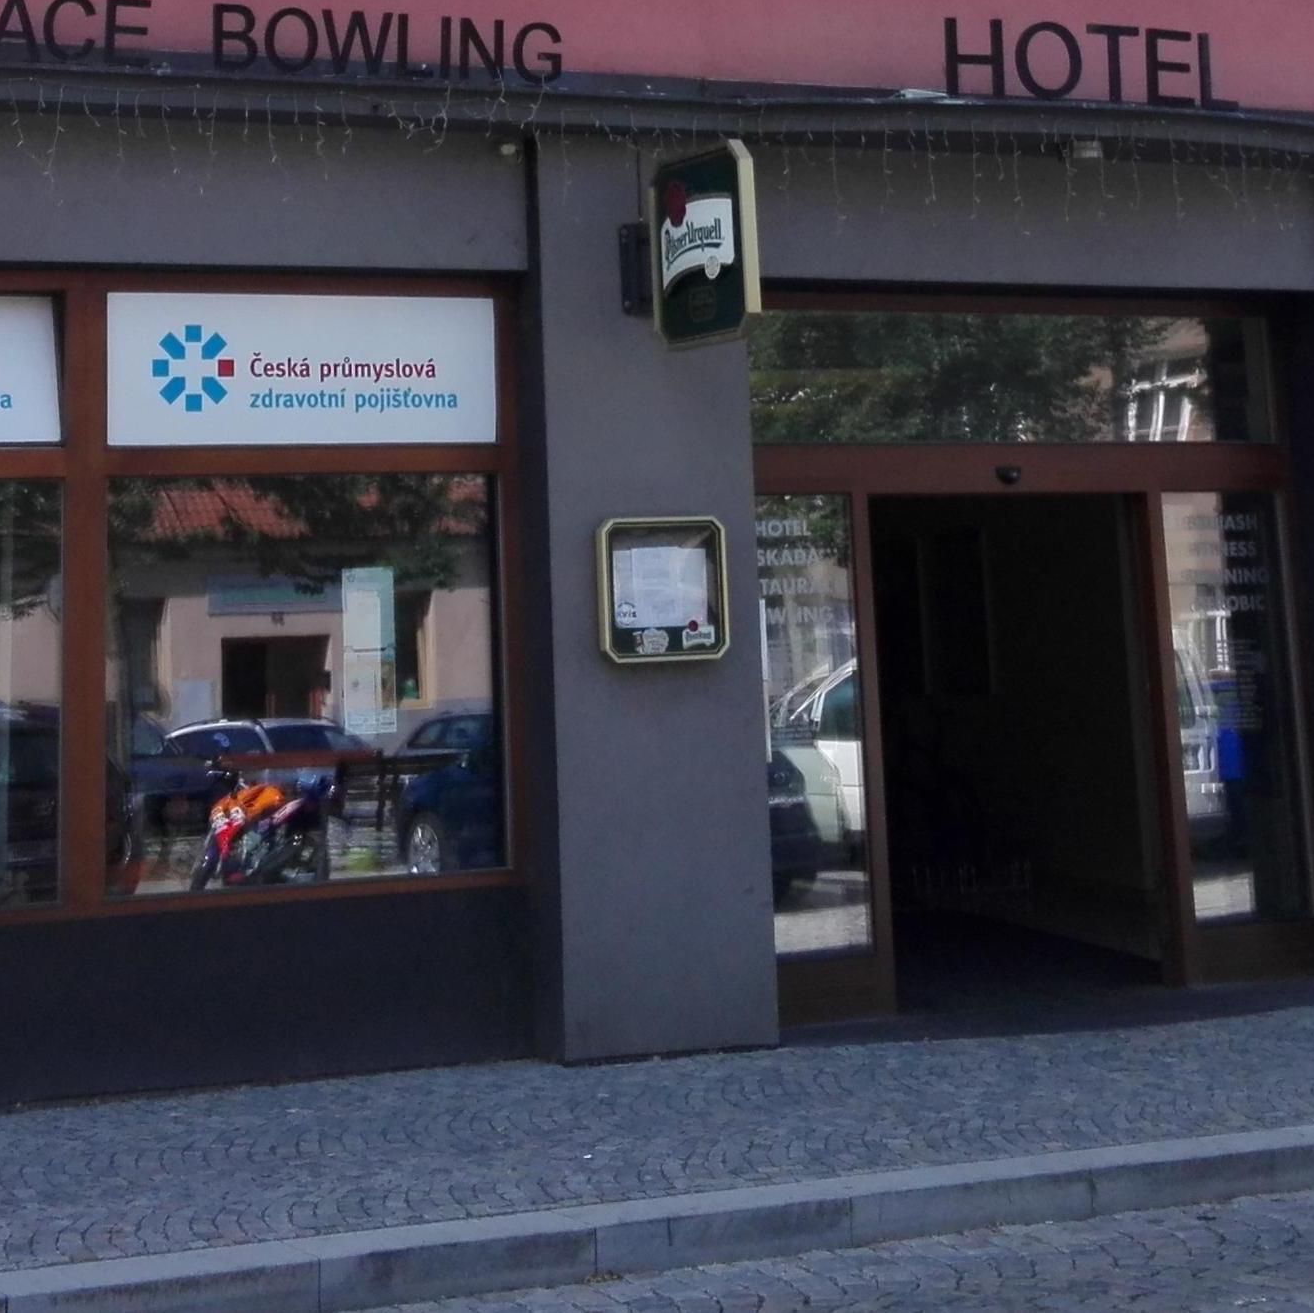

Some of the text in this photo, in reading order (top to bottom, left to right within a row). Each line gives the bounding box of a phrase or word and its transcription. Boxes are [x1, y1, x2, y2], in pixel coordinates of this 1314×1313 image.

[212, 3, 562, 83] BOWLING
[944, 17, 1239, 109] HOTEL
[686, 218, 721, 252] Urquell
[250, 353, 436, 383] Česká průmyslová
[250, 388, 458, 413] zdravotní pojišťovna
[756, 519, 811, 537] HOTEL
[757, 543, 819, 566] SKÁDA
